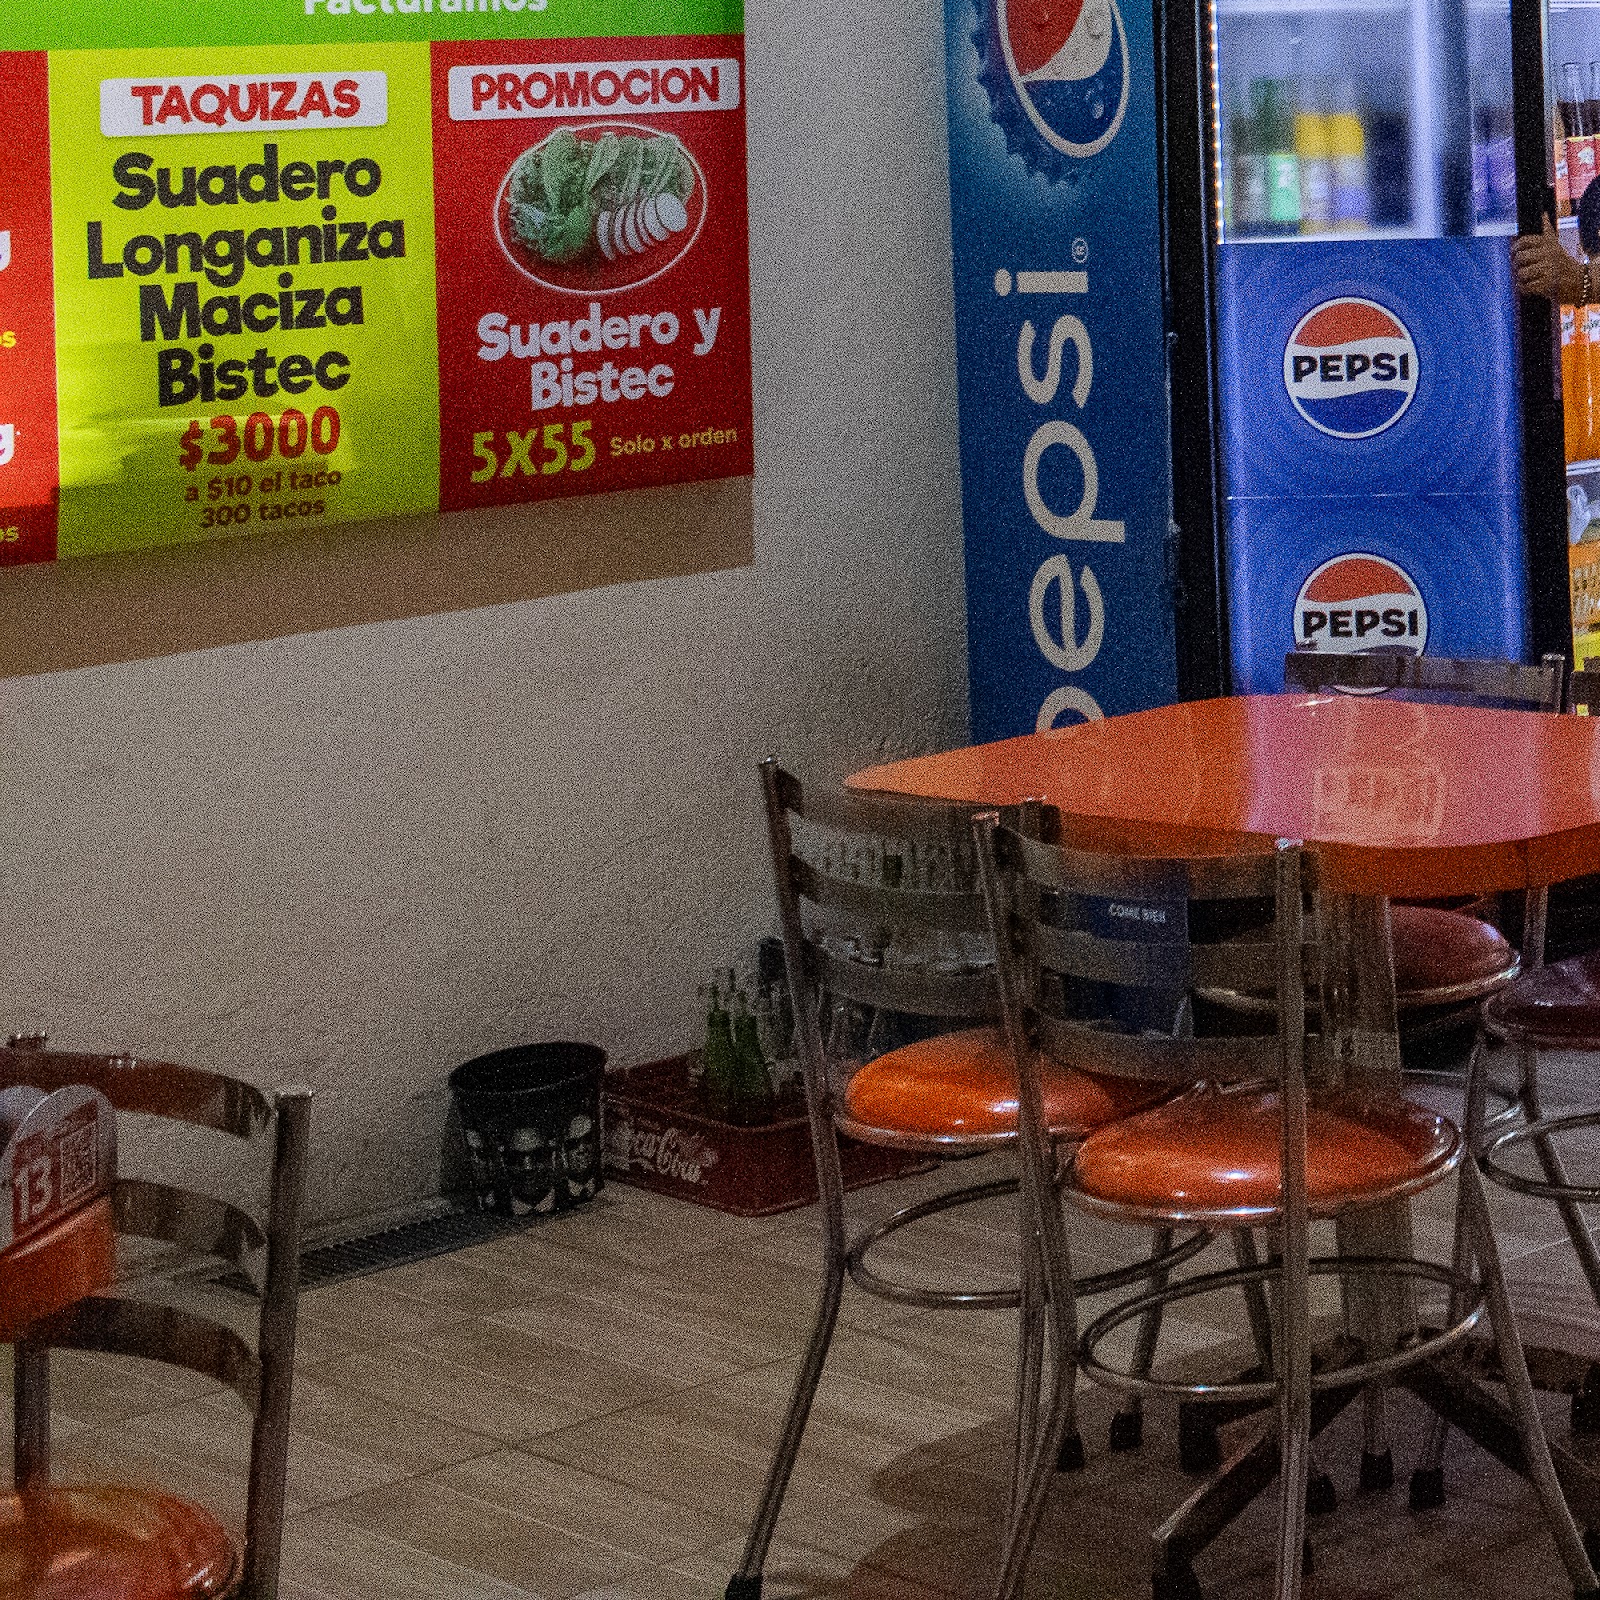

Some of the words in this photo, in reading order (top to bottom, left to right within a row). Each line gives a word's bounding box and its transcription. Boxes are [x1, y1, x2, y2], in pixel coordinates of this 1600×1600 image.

[131, 80, 361, 127] TAQUIZAS
[471, 67, 721, 111] PROMOCION
[112, 144, 382, 210] Suadero
[87, 206, 406, 288] Longaniza
[140, 272, 364, 341] Maciza
[476, 305, 680, 362] Suadero
[693, 305, 721, 353] y
[158, 344, 351, 407] Bistec
[529, 357, 676, 412] Bistec
[1293, 352, 1411, 383] PEPSI
[179, 405, 341, 472] $3000
[609, 431, 655, 457] Solo
[660, 435, 675, 449] x
[678, 425, 739, 450] orden
[185, 486, 199, 501] a
[206, 474, 253, 502] $10
[259, 474, 283, 494] el
[287, 469, 342, 489] taco
[201, 505, 251, 529] 300
[258, 500, 325, 523] tacos
[1303, 608, 1419, 639] PEPSI
[14, 1155, 53, 1223] 13
